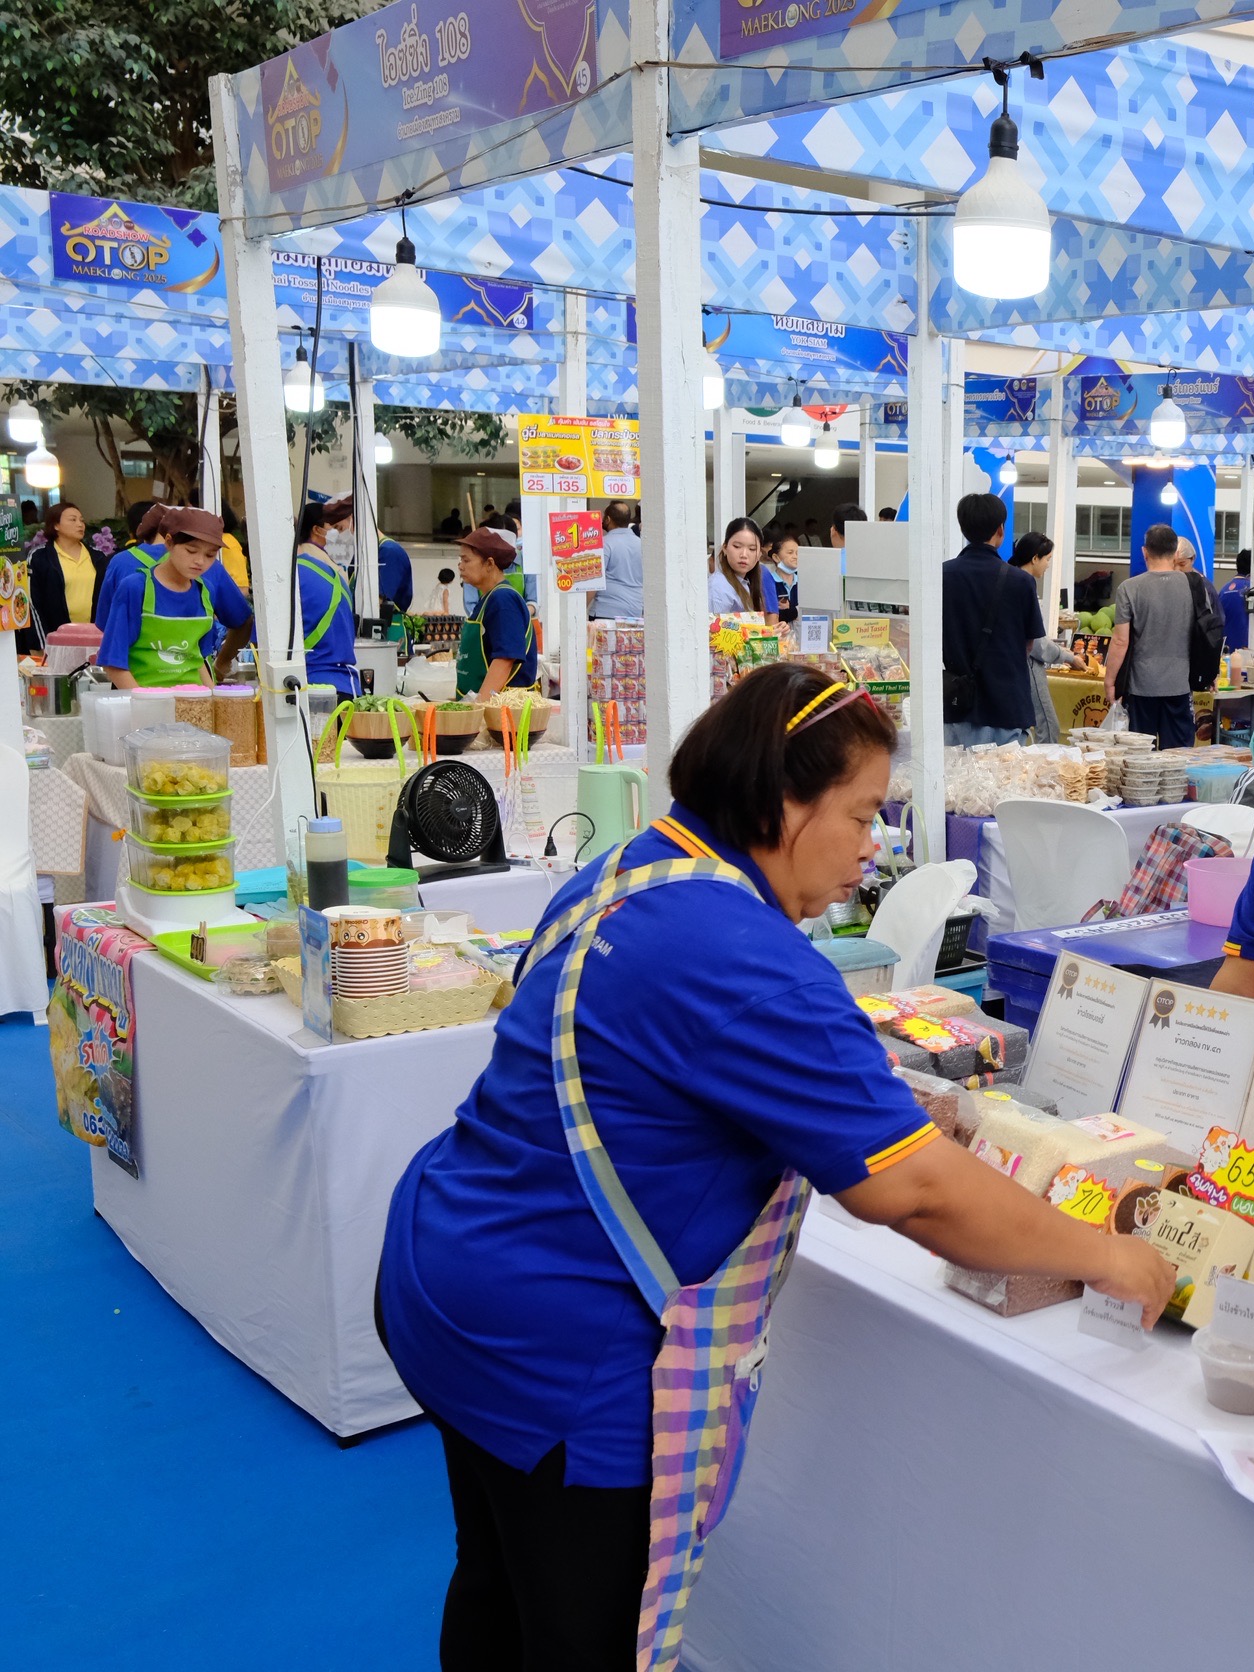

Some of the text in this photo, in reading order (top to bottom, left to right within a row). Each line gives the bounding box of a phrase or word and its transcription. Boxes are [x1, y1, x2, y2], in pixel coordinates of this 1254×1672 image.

[740, 0, 857, 39] MAEKLONG 2025
[437, 13, 471, 68] 108
[434, 73, 450, 101] 108
[272, 108, 322, 161] OTOP
[83, 225, 150, 243] ROADSHOW
[65, 235, 170, 272] OTOP
[72, 264, 168, 284] MAEKLONG 2025
[272, 274, 288, 287] hai
[330, 279, 371, 295] Noodles
[514, 316, 526, 327] 44
[790, 335, 828, 349] YOK SIAM
[1157, 377, 1221, 396] เร์เกอร์แบร์
[886, 404, 908, 415] OTO
[1084, 395, 1120, 411] OTOP
[742, 419, 755, 427] Food
[763, 419, 783, 428] Bevera
[813, 423, 838, 433] Shoing
[567, 522, 579, 550] 1
[722, 631, 738, 645] 100
[856, 625, 870, 634] Thai
[1072, 694, 1102, 717] BURGER
[1156, 996, 1174, 1005] OTOP
[1070, 1189, 1104, 1216] 70
